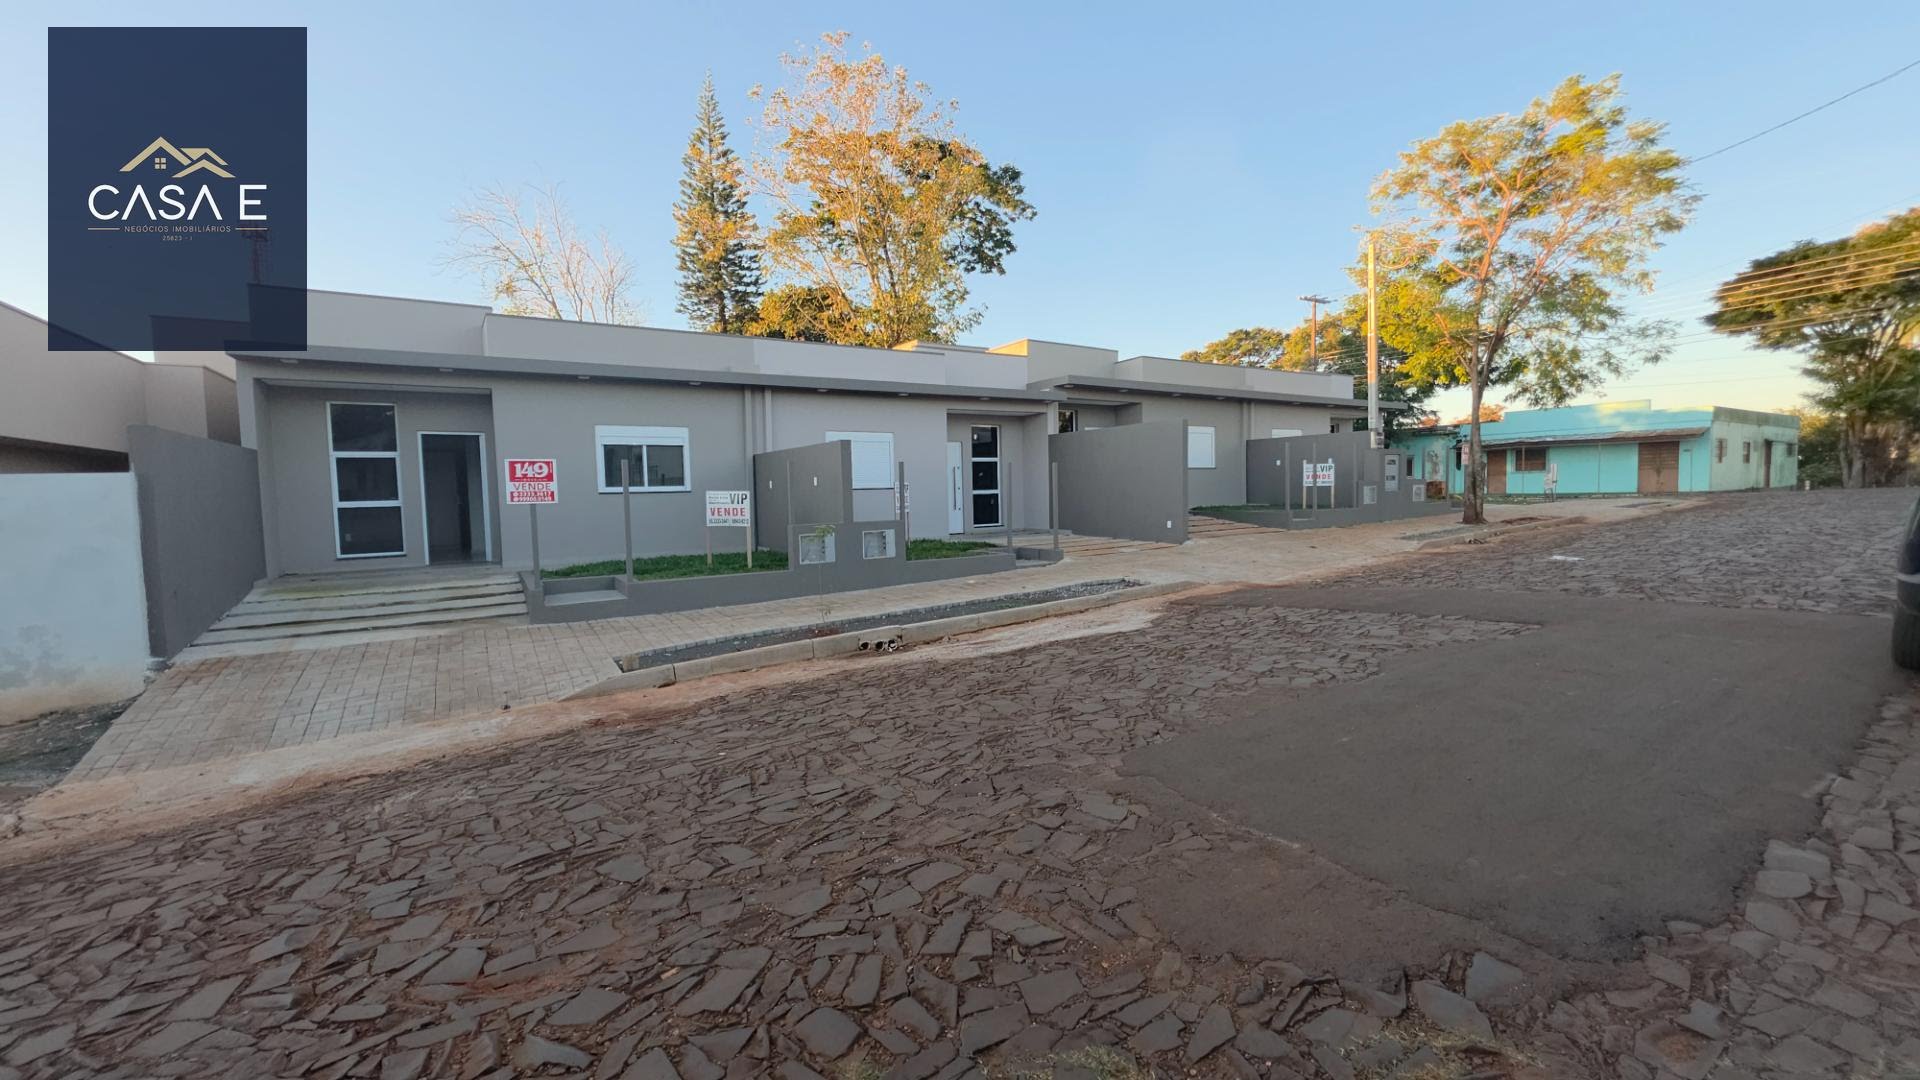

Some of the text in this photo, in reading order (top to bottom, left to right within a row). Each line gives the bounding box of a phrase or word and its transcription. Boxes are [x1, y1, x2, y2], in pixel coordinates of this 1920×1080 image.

[514, 462, 548, 478] 149
[1320, 465, 1333, 473] VIP
[729, 493, 747, 504] VIP
[711, 508, 745, 516] VENDE
